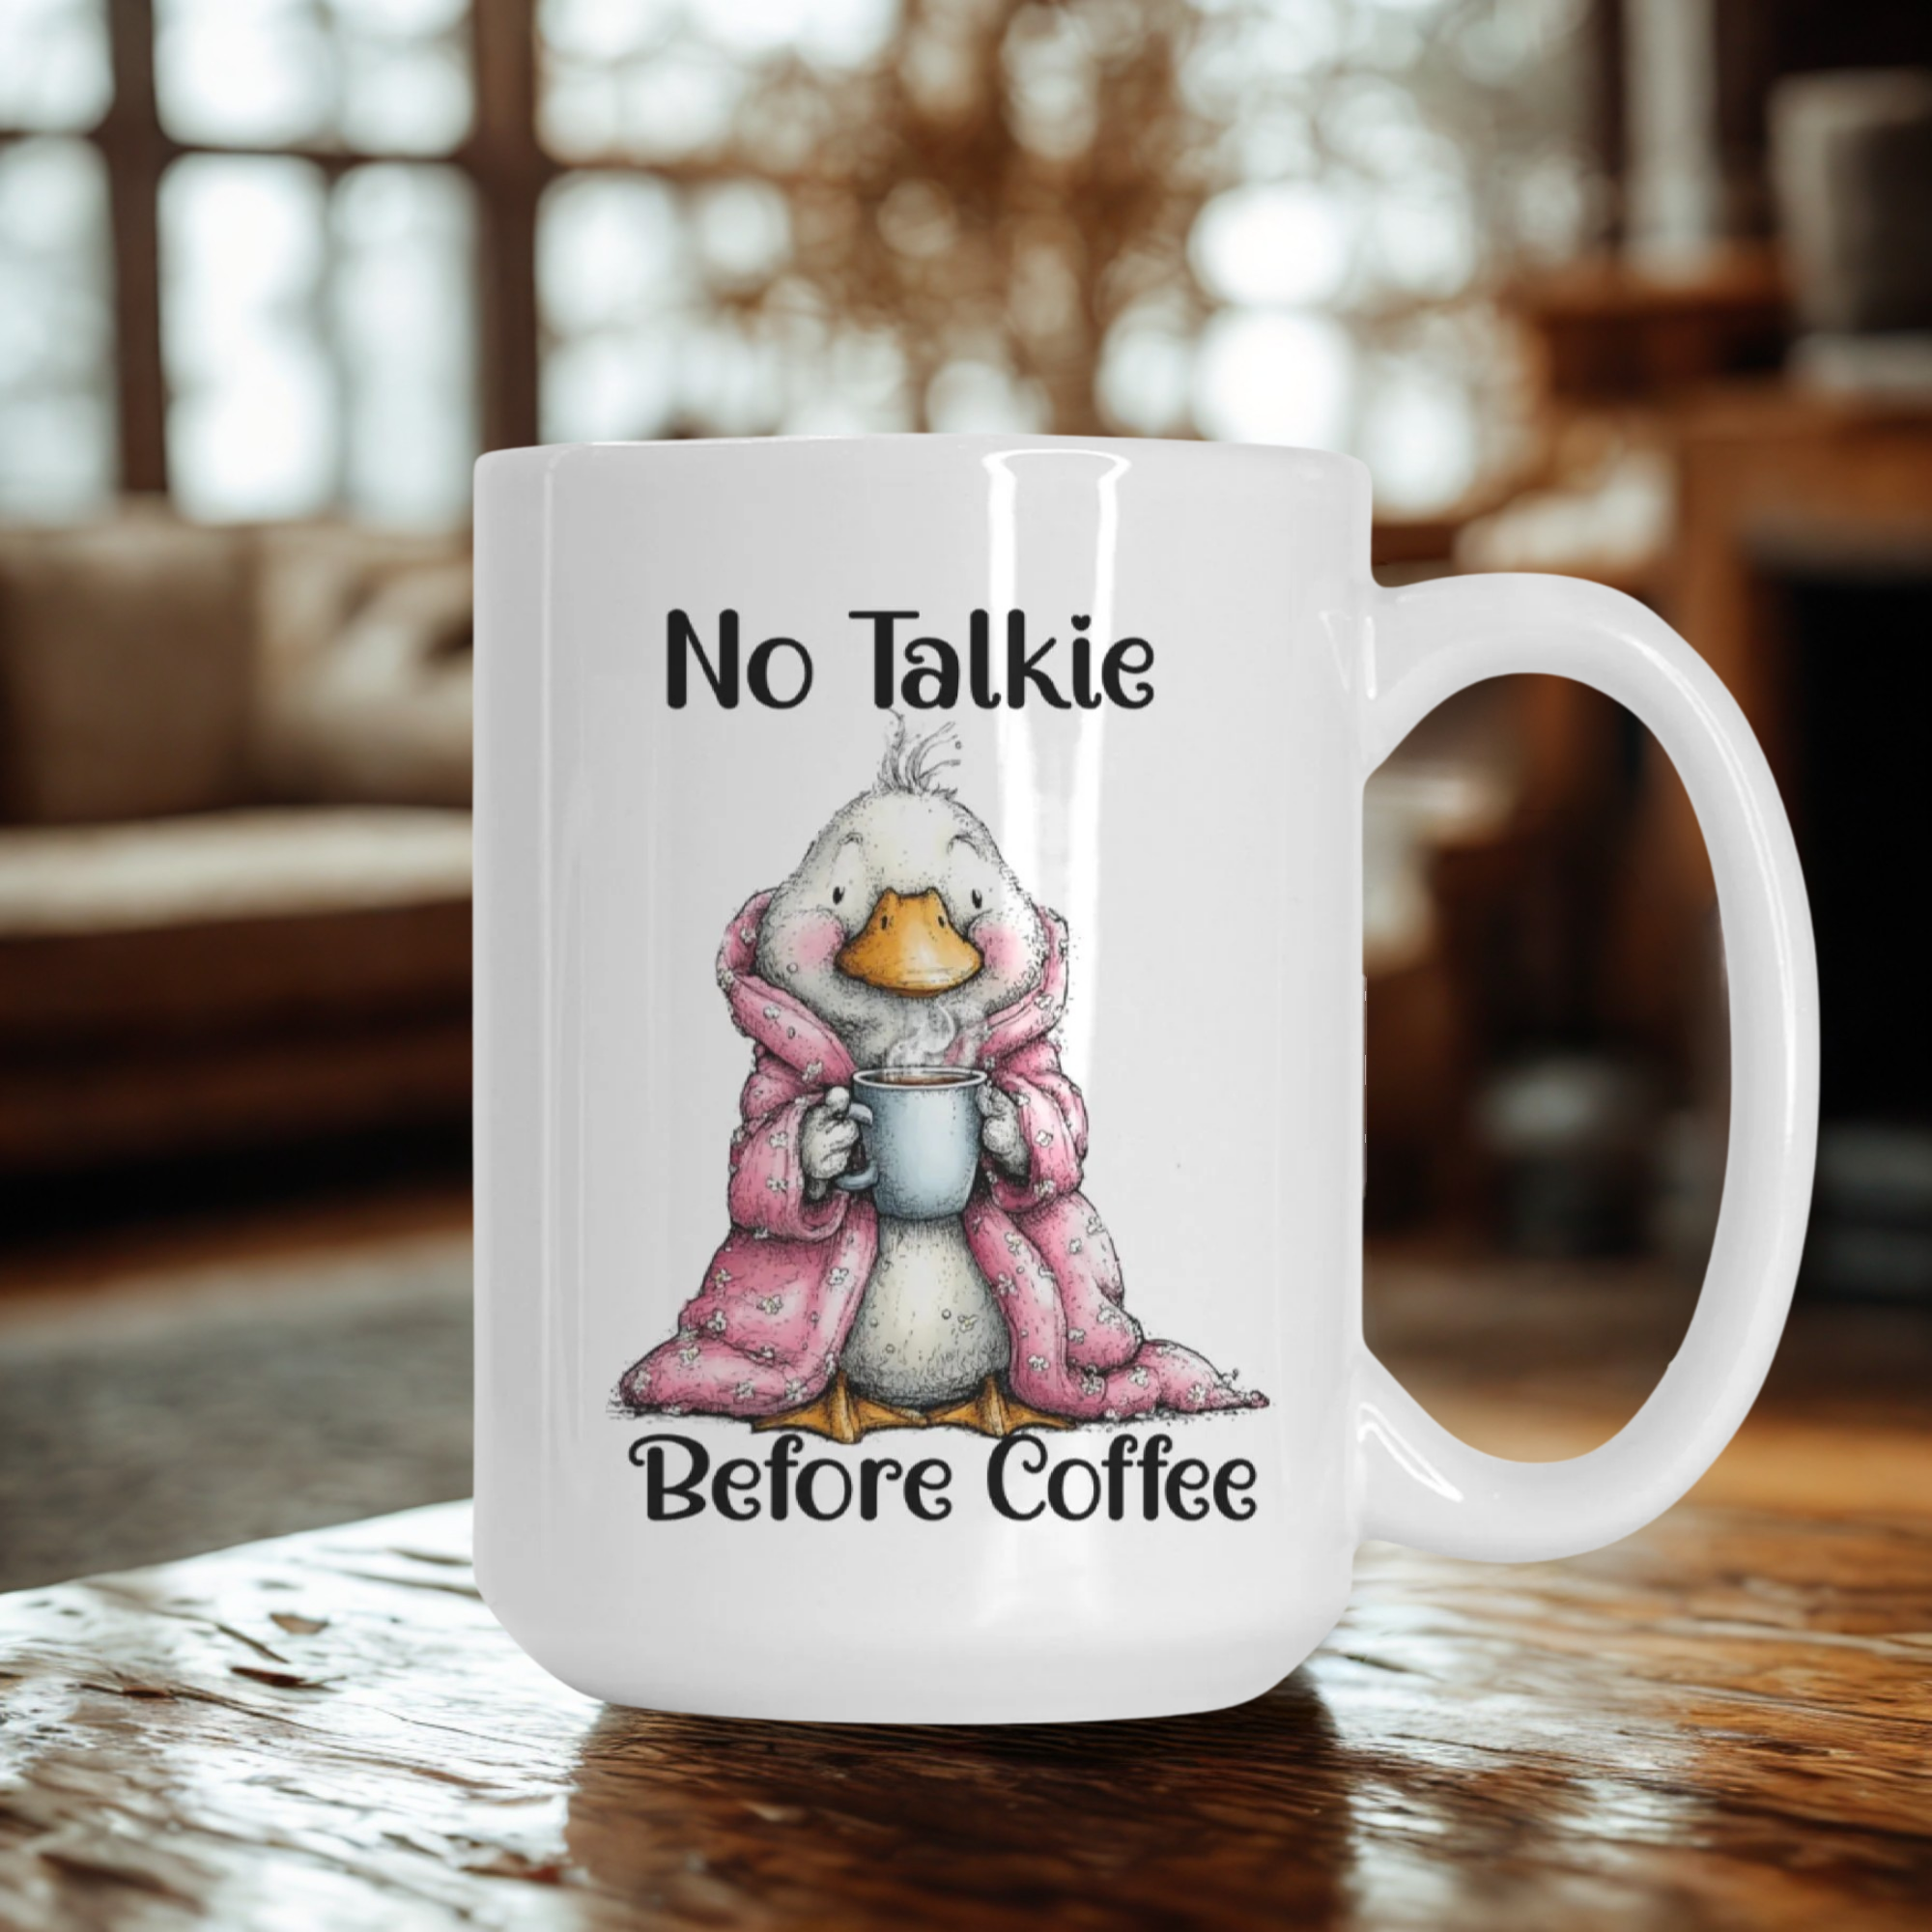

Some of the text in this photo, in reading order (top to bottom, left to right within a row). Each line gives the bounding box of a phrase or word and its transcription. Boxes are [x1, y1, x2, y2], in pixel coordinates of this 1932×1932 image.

[667, 609, 1155, 709] No Talkie
[628, 1434, 1257, 1520] Before Coffee
